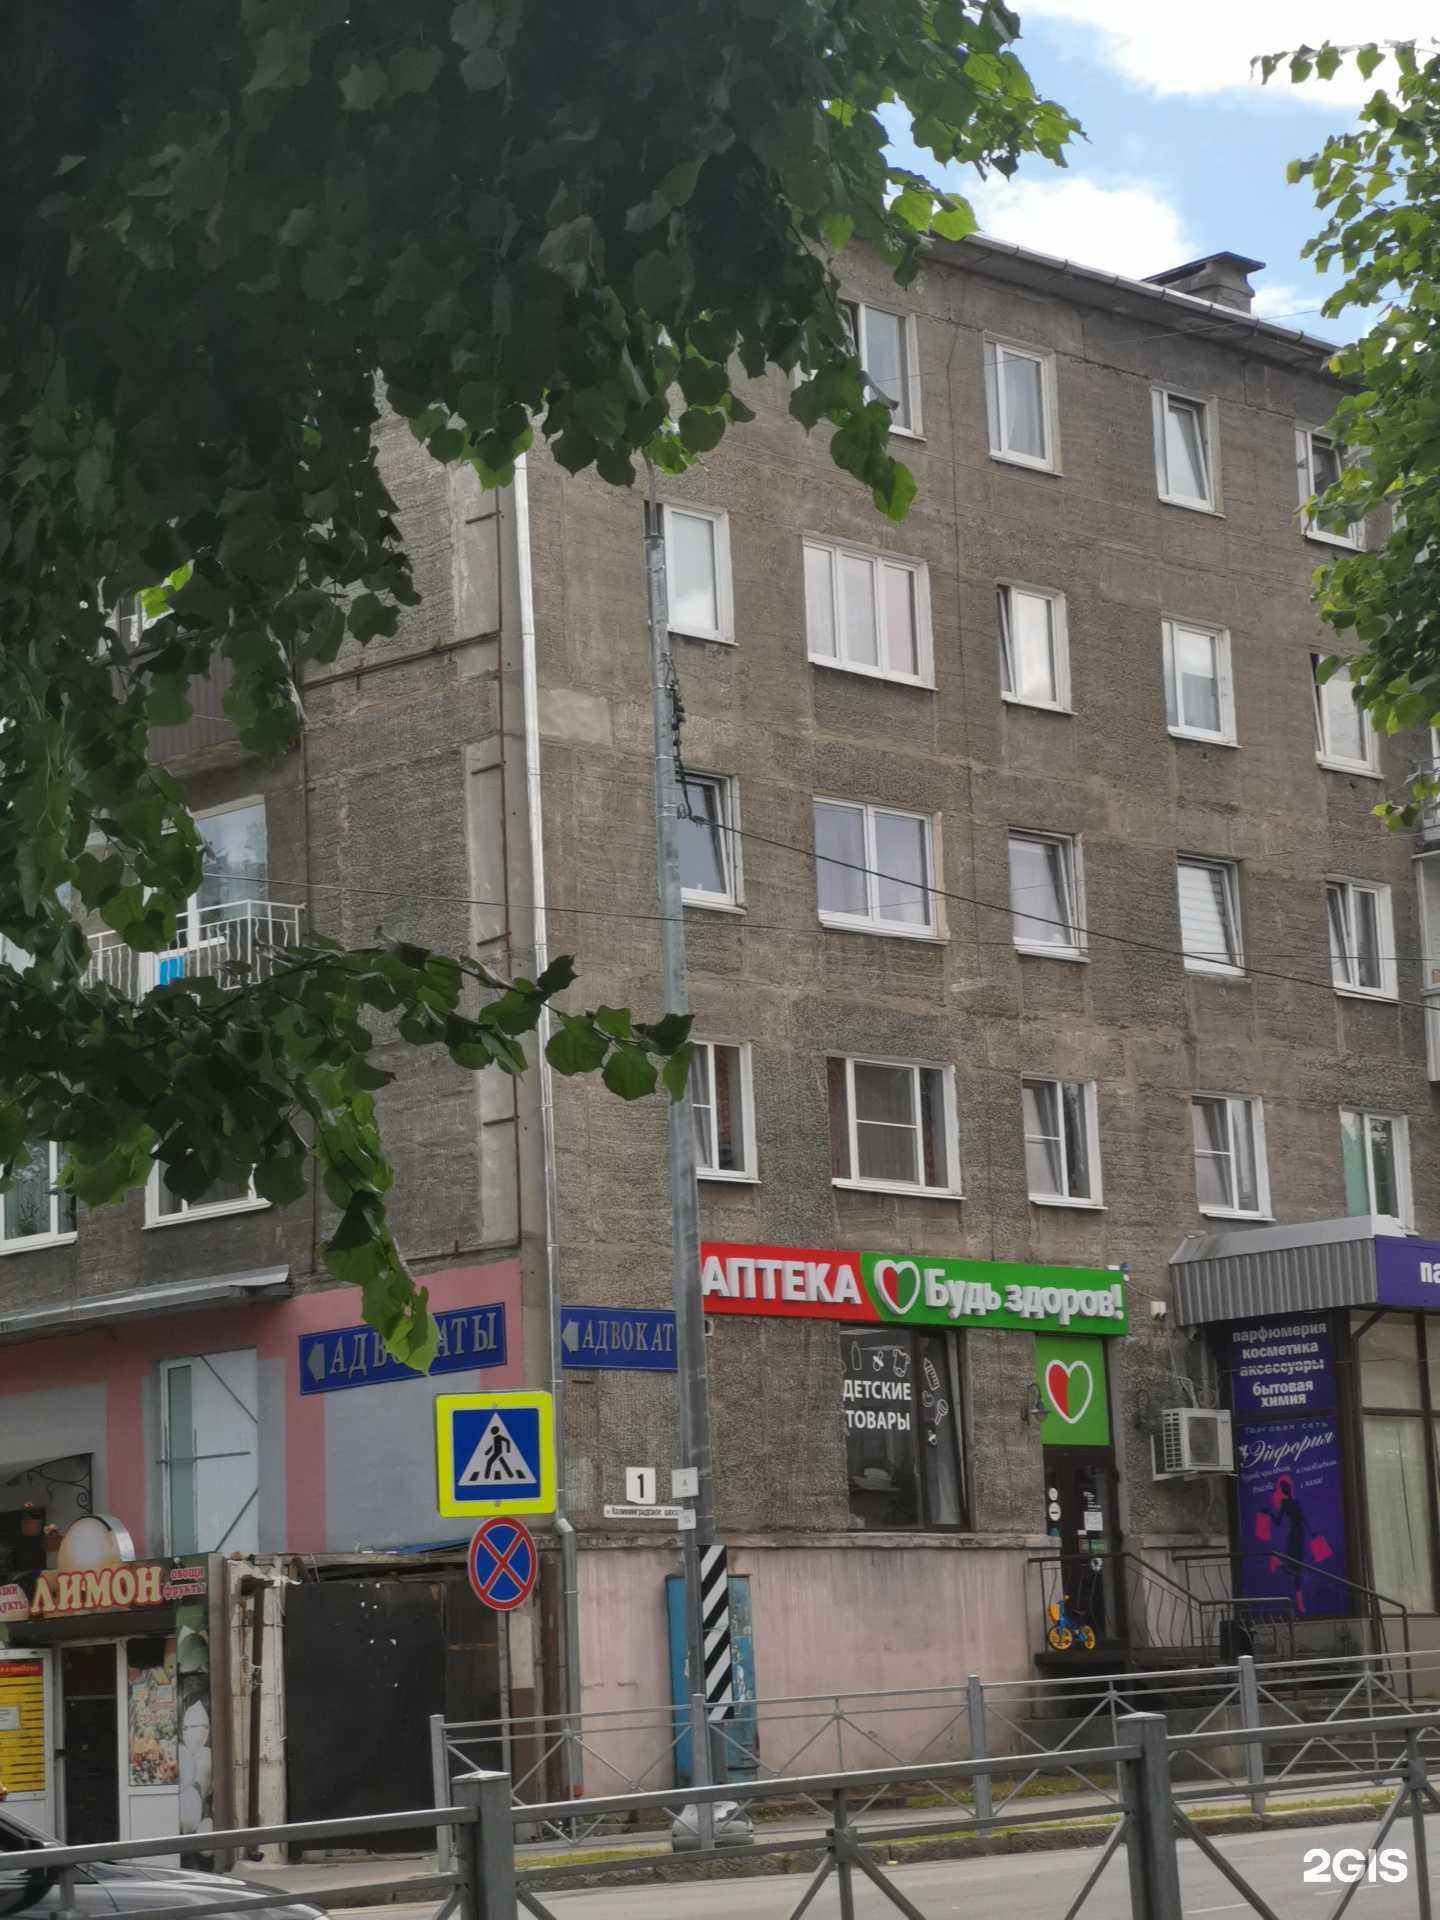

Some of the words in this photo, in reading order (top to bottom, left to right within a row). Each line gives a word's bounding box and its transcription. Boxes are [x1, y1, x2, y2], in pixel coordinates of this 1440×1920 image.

[702, 1256, 862, 1304] АПТЕКА
[924, 1268, 1001, 1319] Будь
[1004, 1283, 1124, 1325] здоров!
[1232, 1323, 1327, 1343] парфюмерия
[328, 1312, 498, 1377] АДВАТЫ
[1242, 1342, 1319, 1359] косметика
[1240, 1359, 1325, 1377] аксессуары
[843, 1379, 912, 1402] ДЕТСКИЕ
[1252, 1380, 1314, 1396] бытовая
[1260, 1393, 1307, 1408] химия
[846, 1410, 911, 1431] ТОВАРЫ
[637, 1472, 644, 1498] 1
[31, 1564, 163, 1615] ЛИМОН
